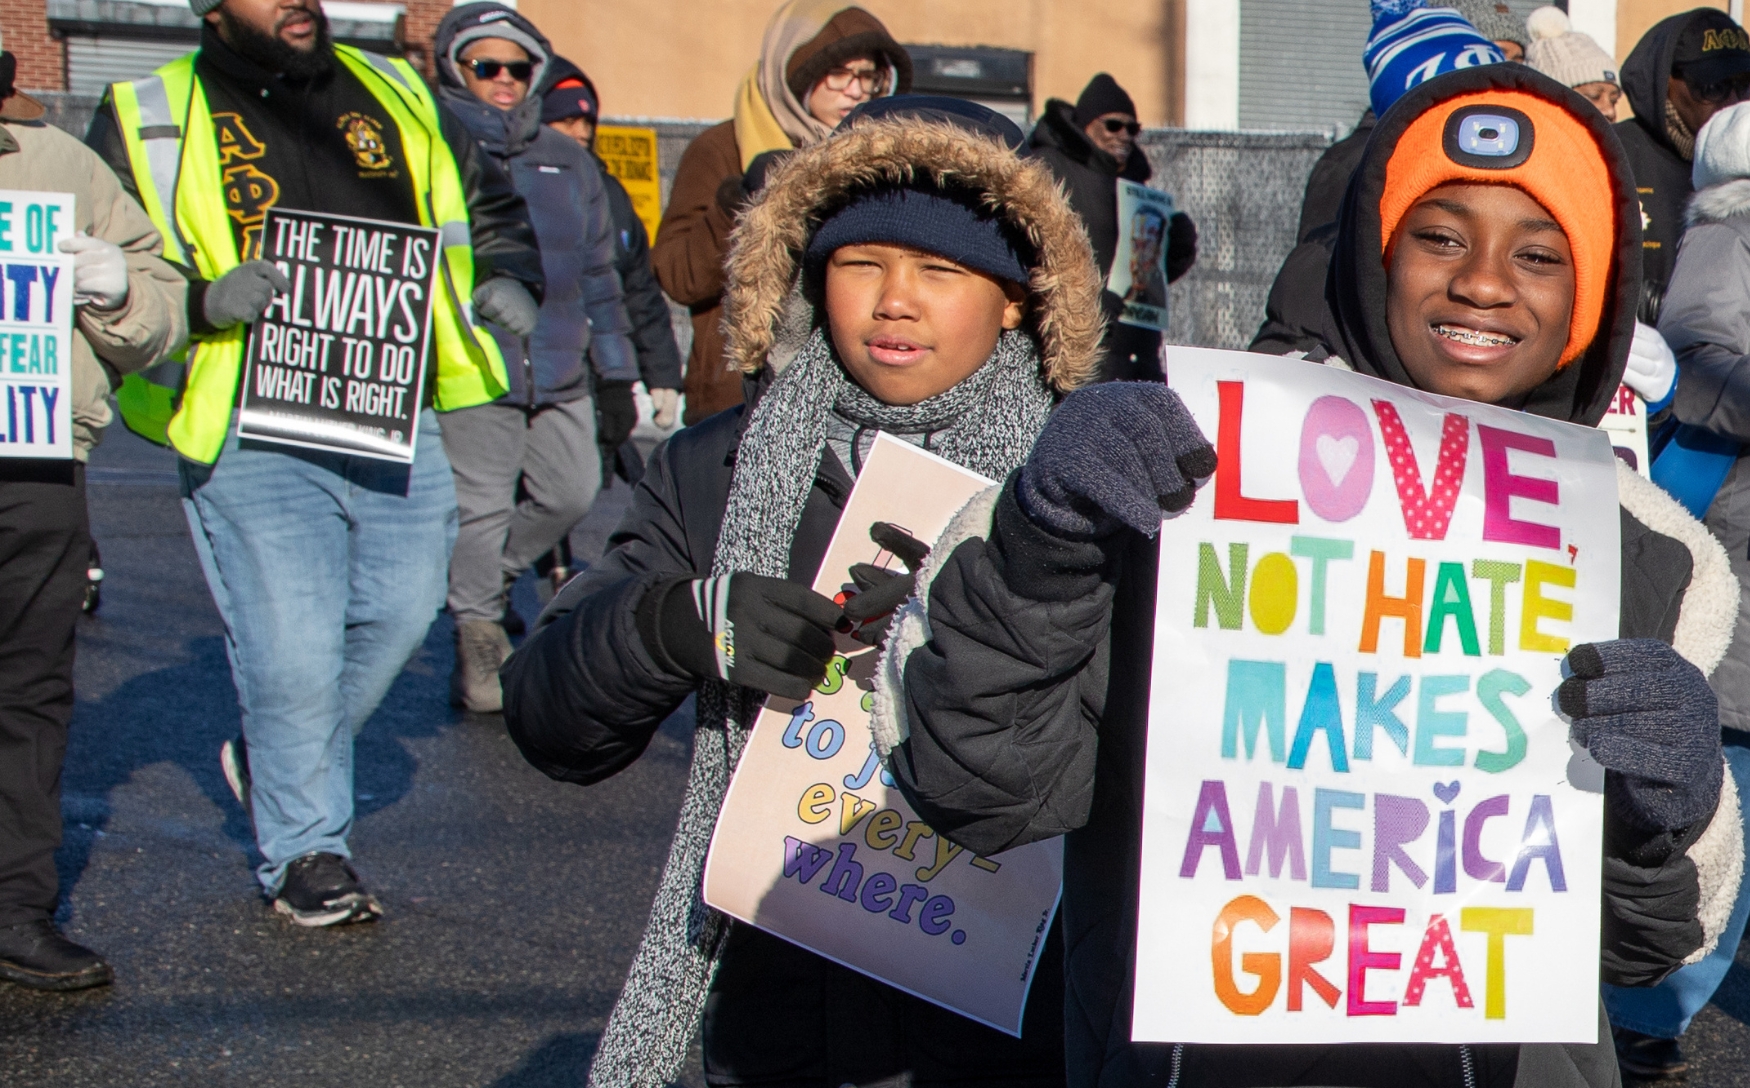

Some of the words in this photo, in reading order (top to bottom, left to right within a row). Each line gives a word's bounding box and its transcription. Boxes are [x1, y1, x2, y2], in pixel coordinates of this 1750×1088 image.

[25, 203, 61, 254] OF
[274, 216, 325, 263] THE
[332, 224, 398, 275] TIME
[402, 235, 430, 280] IS
[263, 260, 424, 344] ALWAYS
[256, 363, 317, 406] WHAT
[319, 374, 343, 410] IS
[345, 379, 409, 421] RIGHT.
[259, 321, 336, 373] RIGHT
[341, 336, 374, 380] TO
[379, 342, 417, 386] DO
[1213, 379, 1579, 566] LOVE,
[1193, 535, 1355, 636] NOT
[1357, 549, 1578, 659] HATE
[781, 700, 847, 761] to
[1220, 659, 1534, 774] MAKES
[797, 782, 1003, 884] every-
[1178, 779, 1569, 895] AMERICA
[783, 835, 967, 946] where.
[1211, 894, 1535, 1021] GREAT
